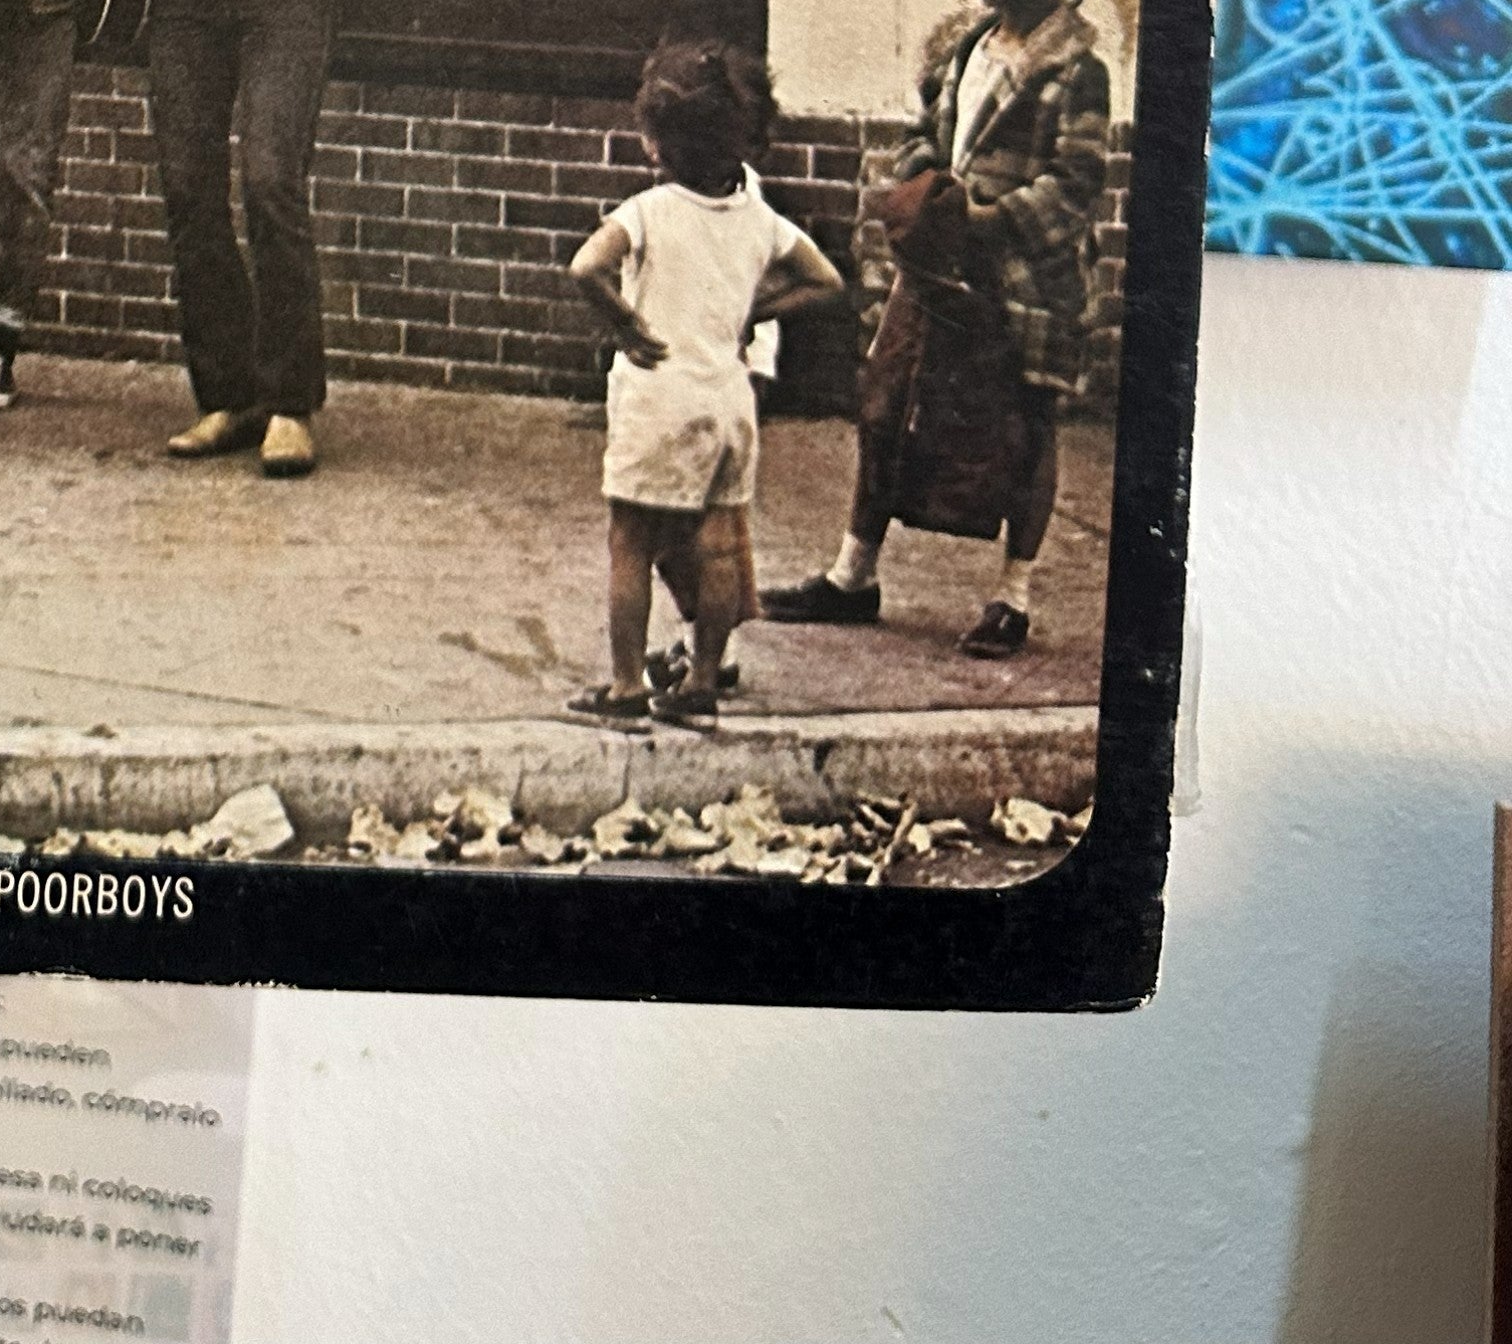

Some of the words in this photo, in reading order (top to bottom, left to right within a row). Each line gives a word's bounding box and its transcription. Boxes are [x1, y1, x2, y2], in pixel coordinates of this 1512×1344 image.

[0, 1039, 111, 1064] pueden
[48, 1169, 78, 1193] ni
[82, 1177, 214, 1215] coloques
[92, 1223, 110, 1242] a
[116, 1228, 200, 1257] poner
[33, 1301, 145, 1336] puedan
